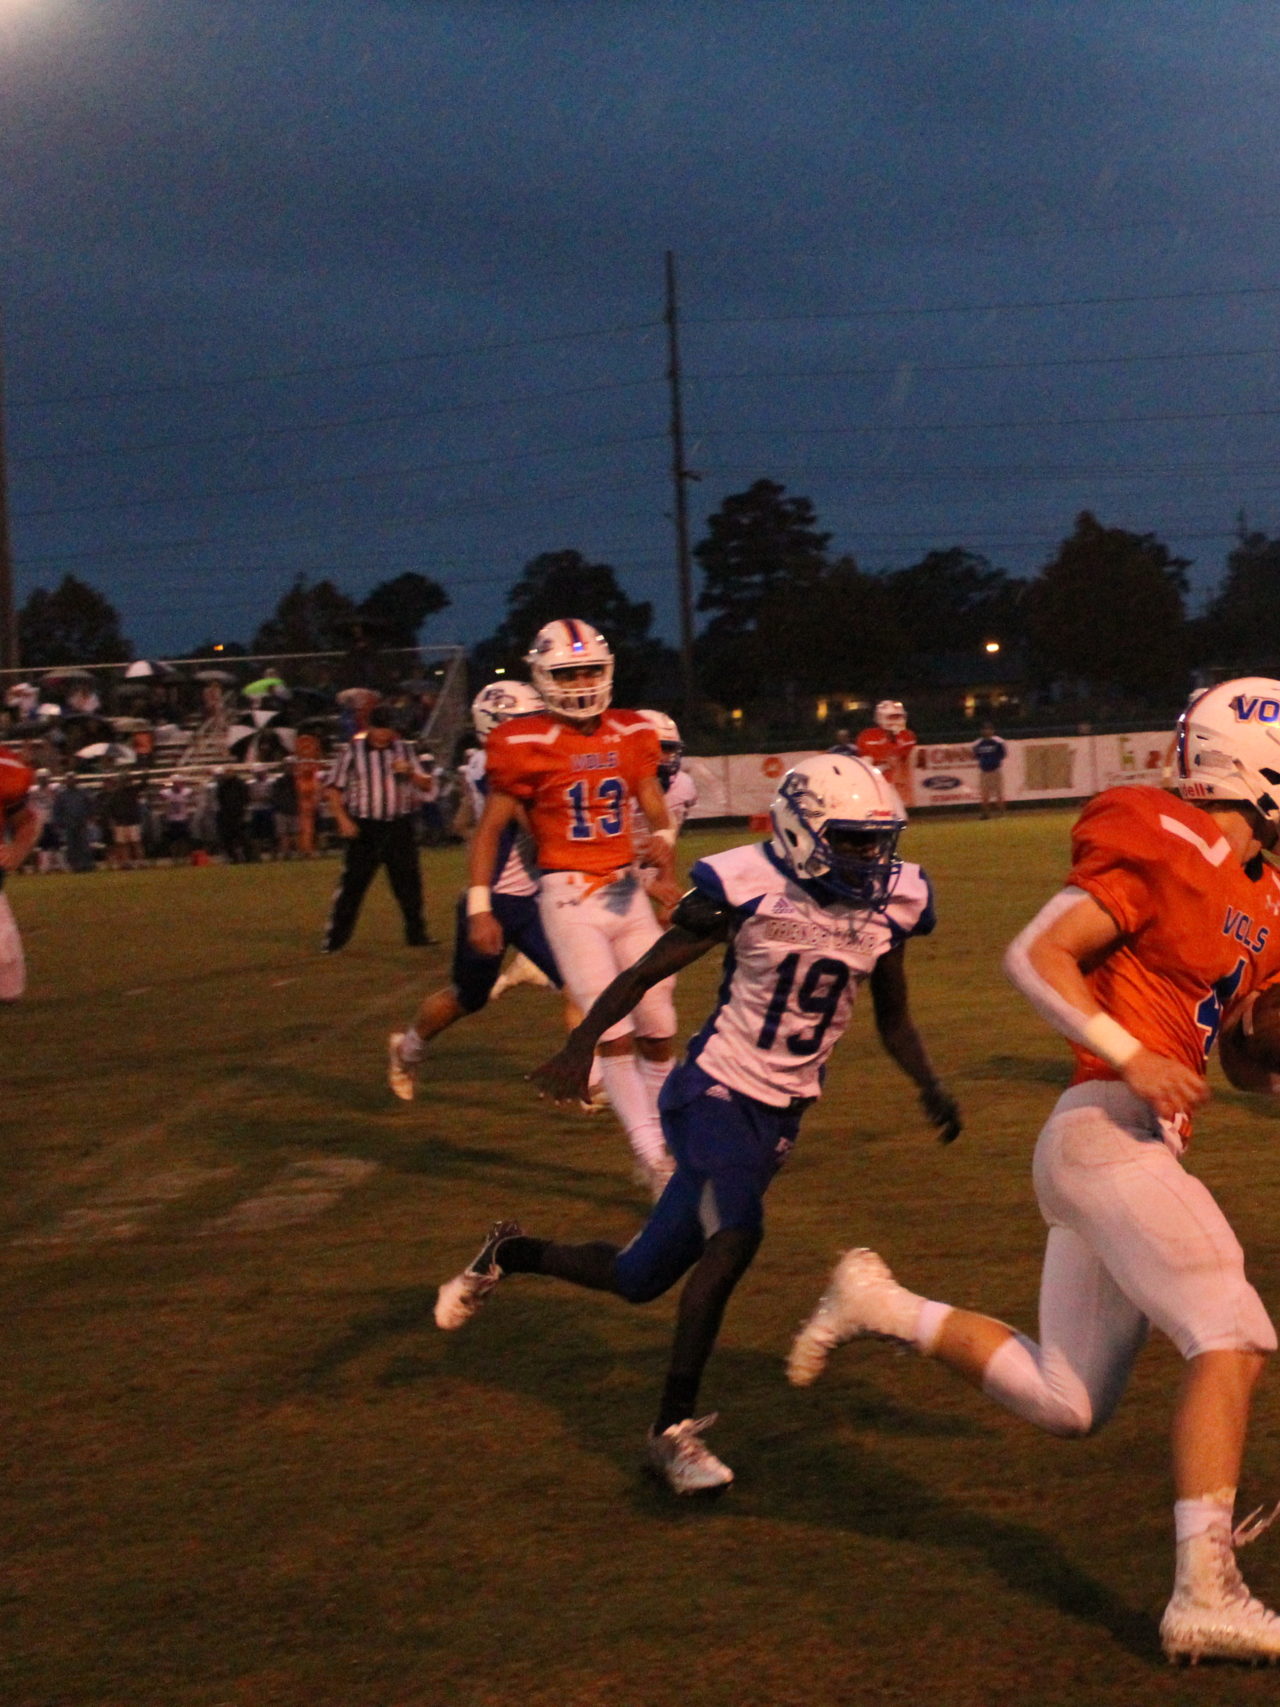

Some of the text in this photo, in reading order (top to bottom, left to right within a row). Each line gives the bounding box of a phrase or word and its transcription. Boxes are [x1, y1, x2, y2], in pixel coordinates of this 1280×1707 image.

[564, 776, 629, 841] 13
[1222, 905, 1270, 954] VOLS
[756, 952, 850, 1056] 19
